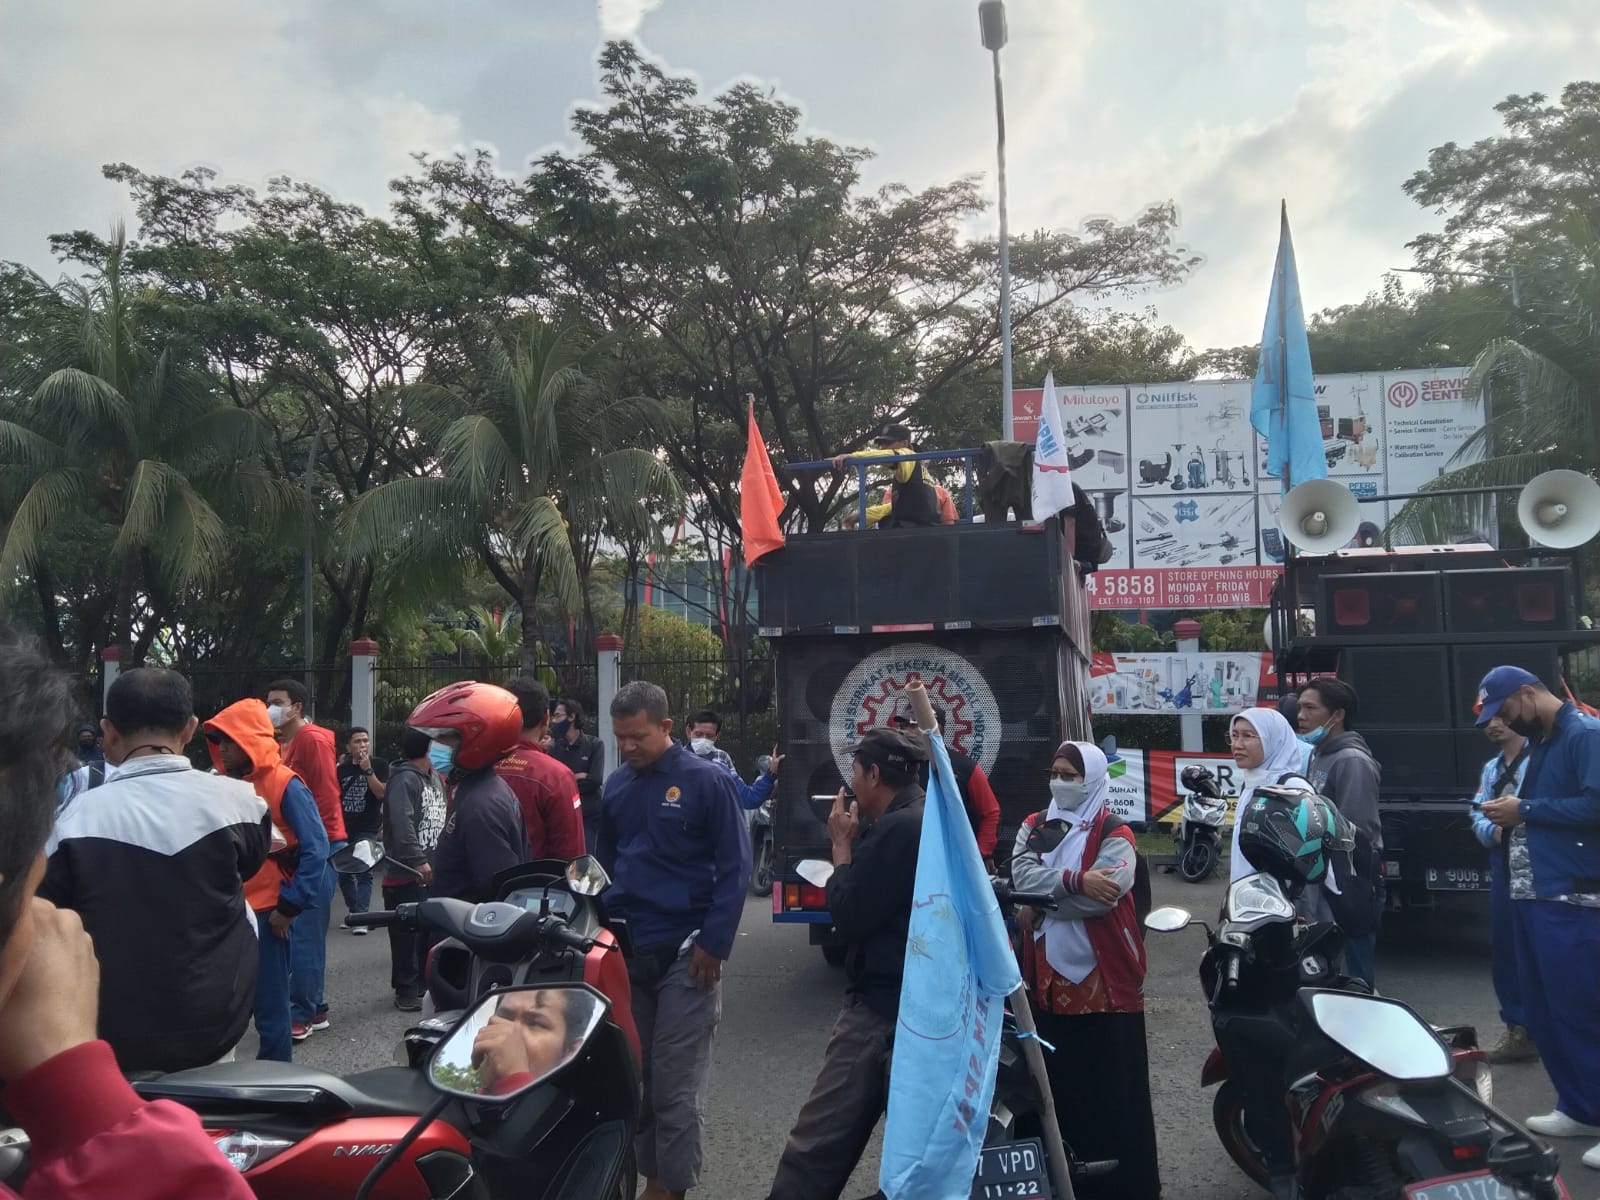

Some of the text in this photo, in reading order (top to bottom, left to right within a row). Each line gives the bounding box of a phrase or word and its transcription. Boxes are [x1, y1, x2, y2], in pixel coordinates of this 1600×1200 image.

[1421, 379, 1476, 390] SERVIC
[1063, 394, 1120, 407] Mitutoyo
[1151, 392, 1198, 403] Nilfisk
[1421, 389, 1478, 401] CENTE
[1168, 569, 1280, 581] STORE OPENING HOURS
[1104, 575, 1155, 595] 5858
[1168, 582, 1208, 592] MONDAY
[1216, 581, 1250, 592] FRIDAY
[1099, 597, 1114, 605] EXT.
[1116, 597, 1132, 605] 1103
[1139, 596, 1155, 604] 1107
[1168, 594, 1195, 604] 08.00
[1204, 593, 1229, 603] 17.00
[1231, 592, 1250, 602] WIB
[886, 658, 946, 676] PEKERJA
[948, 670, 980, 709] METAL
[1429, 868, 1438, 881] B
[998, 1150, 1035, 1174] VPD
